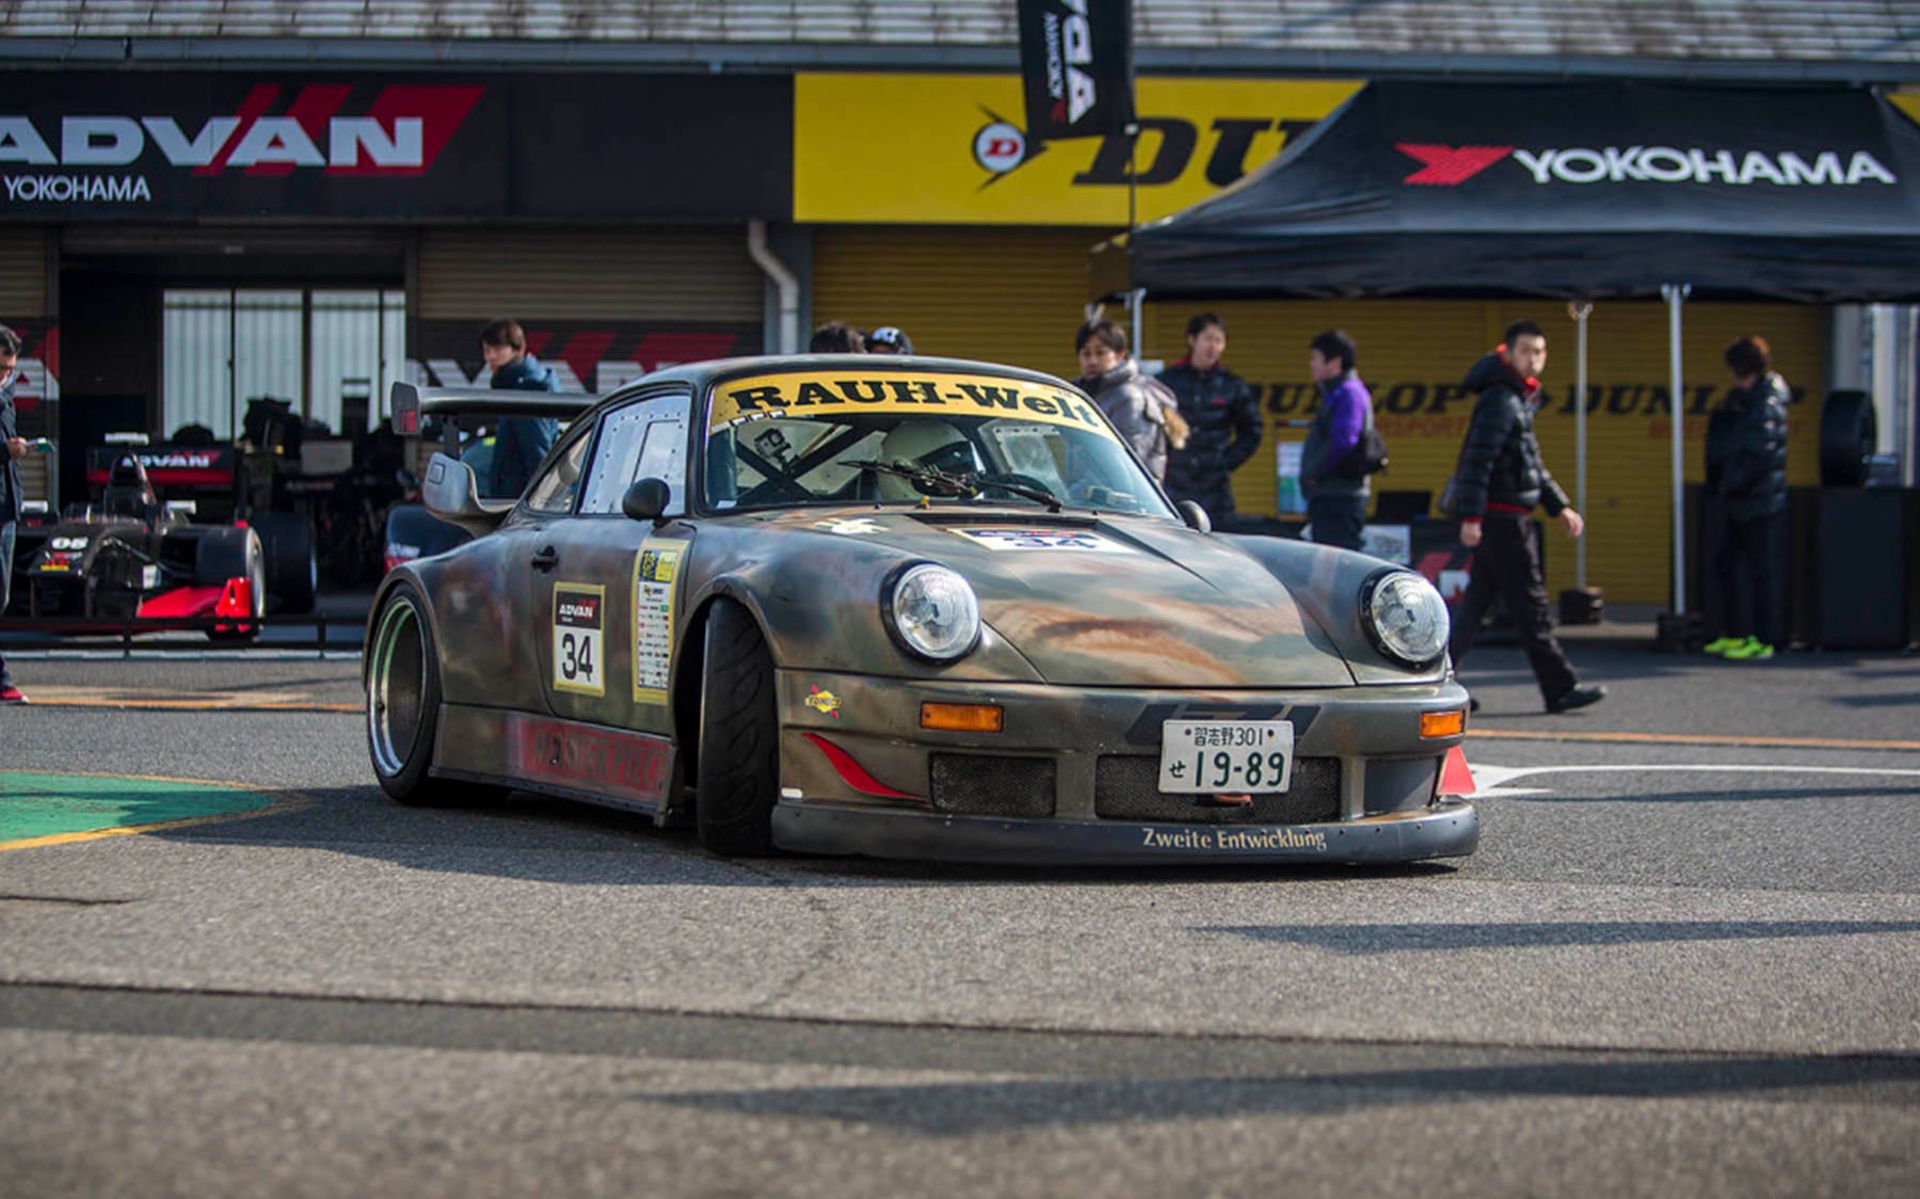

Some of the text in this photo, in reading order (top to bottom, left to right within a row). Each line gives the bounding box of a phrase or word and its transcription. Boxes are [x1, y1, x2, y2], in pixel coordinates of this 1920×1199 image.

[0, 115, 423, 166] ADVAN
[1513, 146, 1896, 185] YOKOHAMA
[4, 174, 151, 201] YOKOHAMA
[728, 379, 1100, 428] RAUH-Welt
[559, 603, 594, 618] ADVAN
[562, 632, 593, 682] 34
[1168, 751, 1285, 787] せ 19-89
[1142, 827, 1327, 851] Zweite Entwicklung
